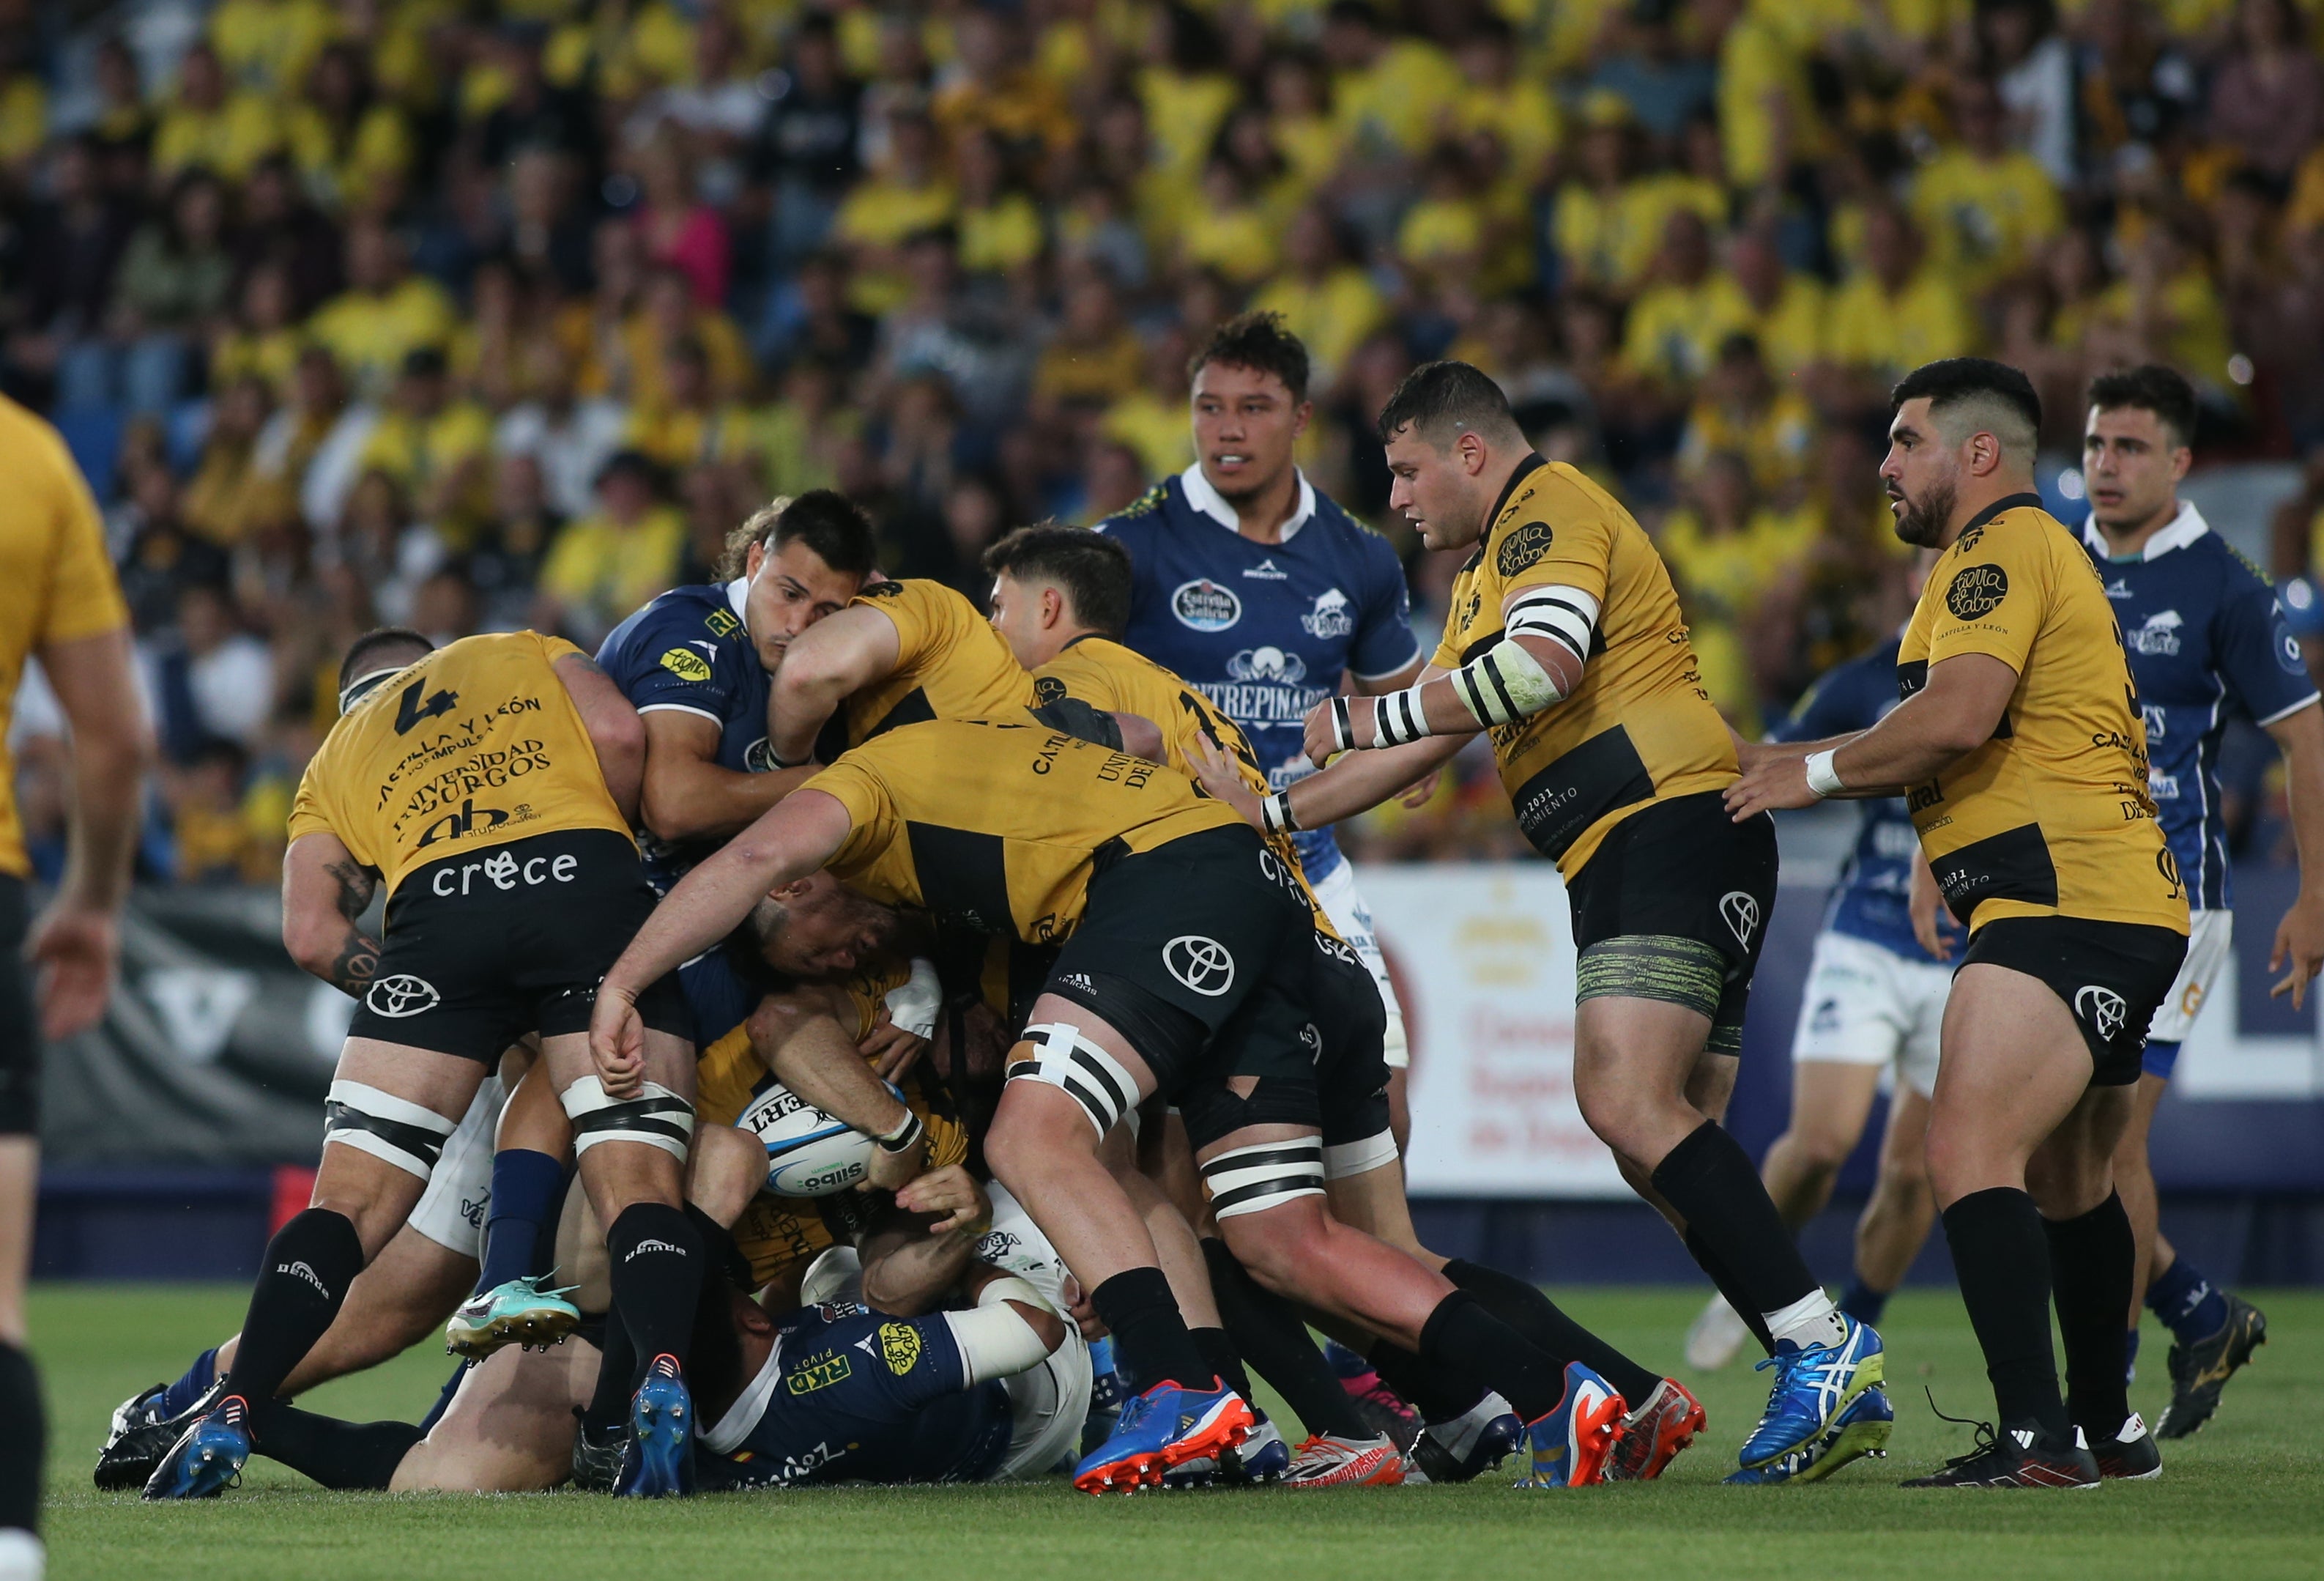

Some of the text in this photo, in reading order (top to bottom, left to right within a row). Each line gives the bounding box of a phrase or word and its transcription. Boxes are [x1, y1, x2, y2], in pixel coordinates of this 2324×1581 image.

[1951, 569, 2006, 591] tierra
[1181, 590, 1233, 609] Estrella
[1951, 588, 1969, 603] de
[1953, 586, 2005, 617] sabor
[1936, 624, 1970, 642] CASTILLA
[1983, 623, 2009, 636] LEÓN
[393, 675, 460, 737] 4
[459, 718, 475, 735] Y
[483, 695, 541, 725] LEÓN
[1528, 787, 1553, 812] 2031
[432, 851, 578, 897] crece
[1058, 976, 1098, 996] adidas
[811, 1160, 844, 1174] Telecom
[793, 1348, 833, 1370] PIVOT
[790, 1356, 850, 1393] RKD
